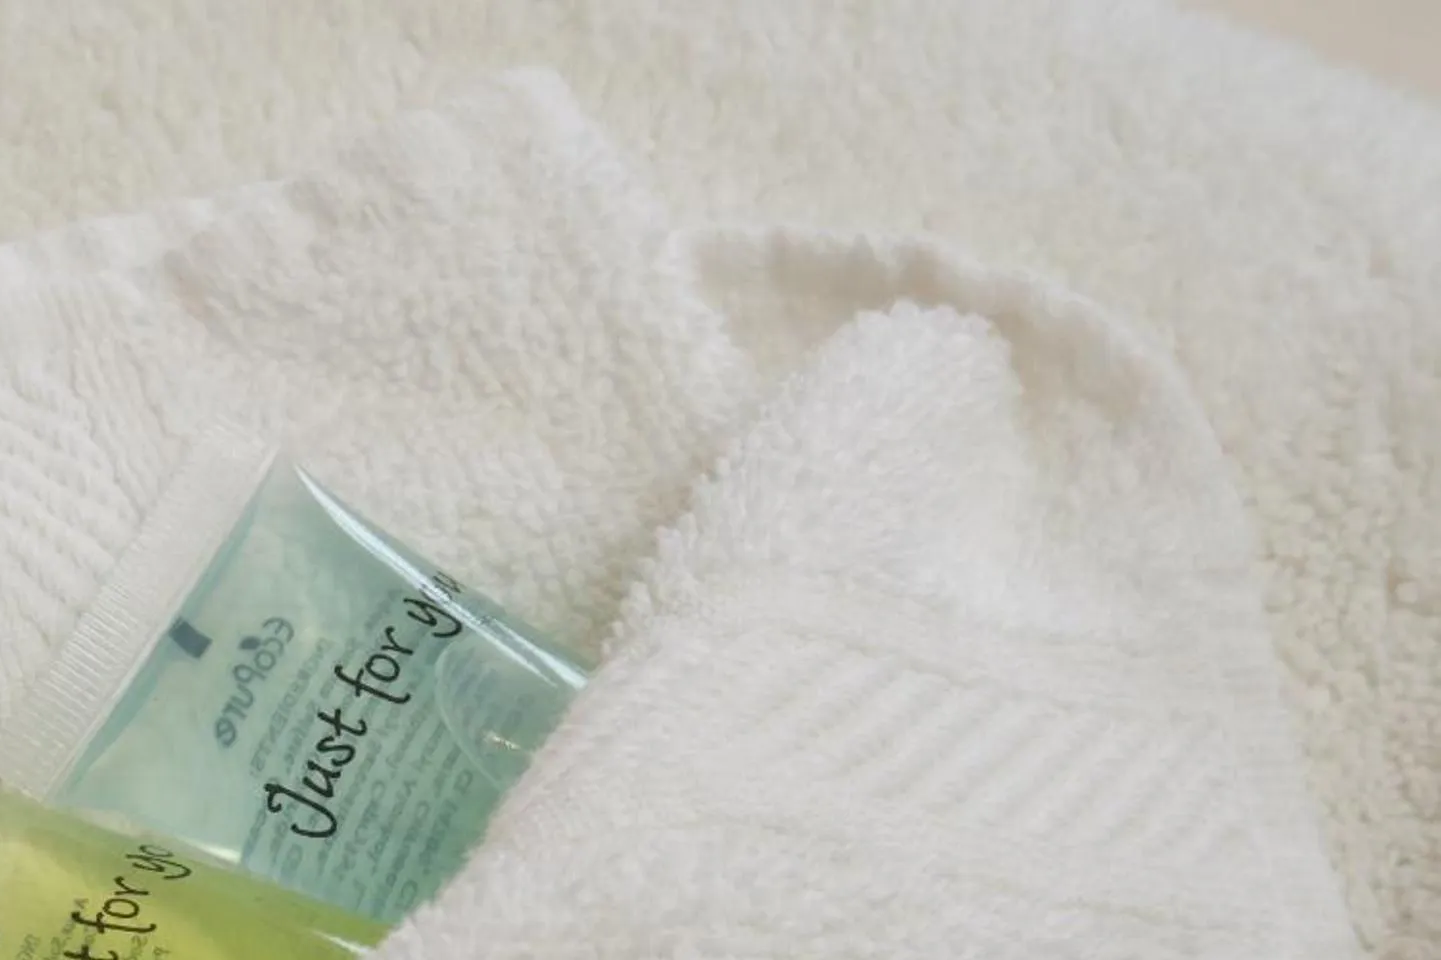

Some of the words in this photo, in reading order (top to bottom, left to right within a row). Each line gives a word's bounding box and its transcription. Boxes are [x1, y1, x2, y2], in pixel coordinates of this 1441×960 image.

[263, 708, 367, 838] Just
[333, 626, 413, 704] for
[71, 876, 157, 934] for
[126, 845, 192, 880] yo
